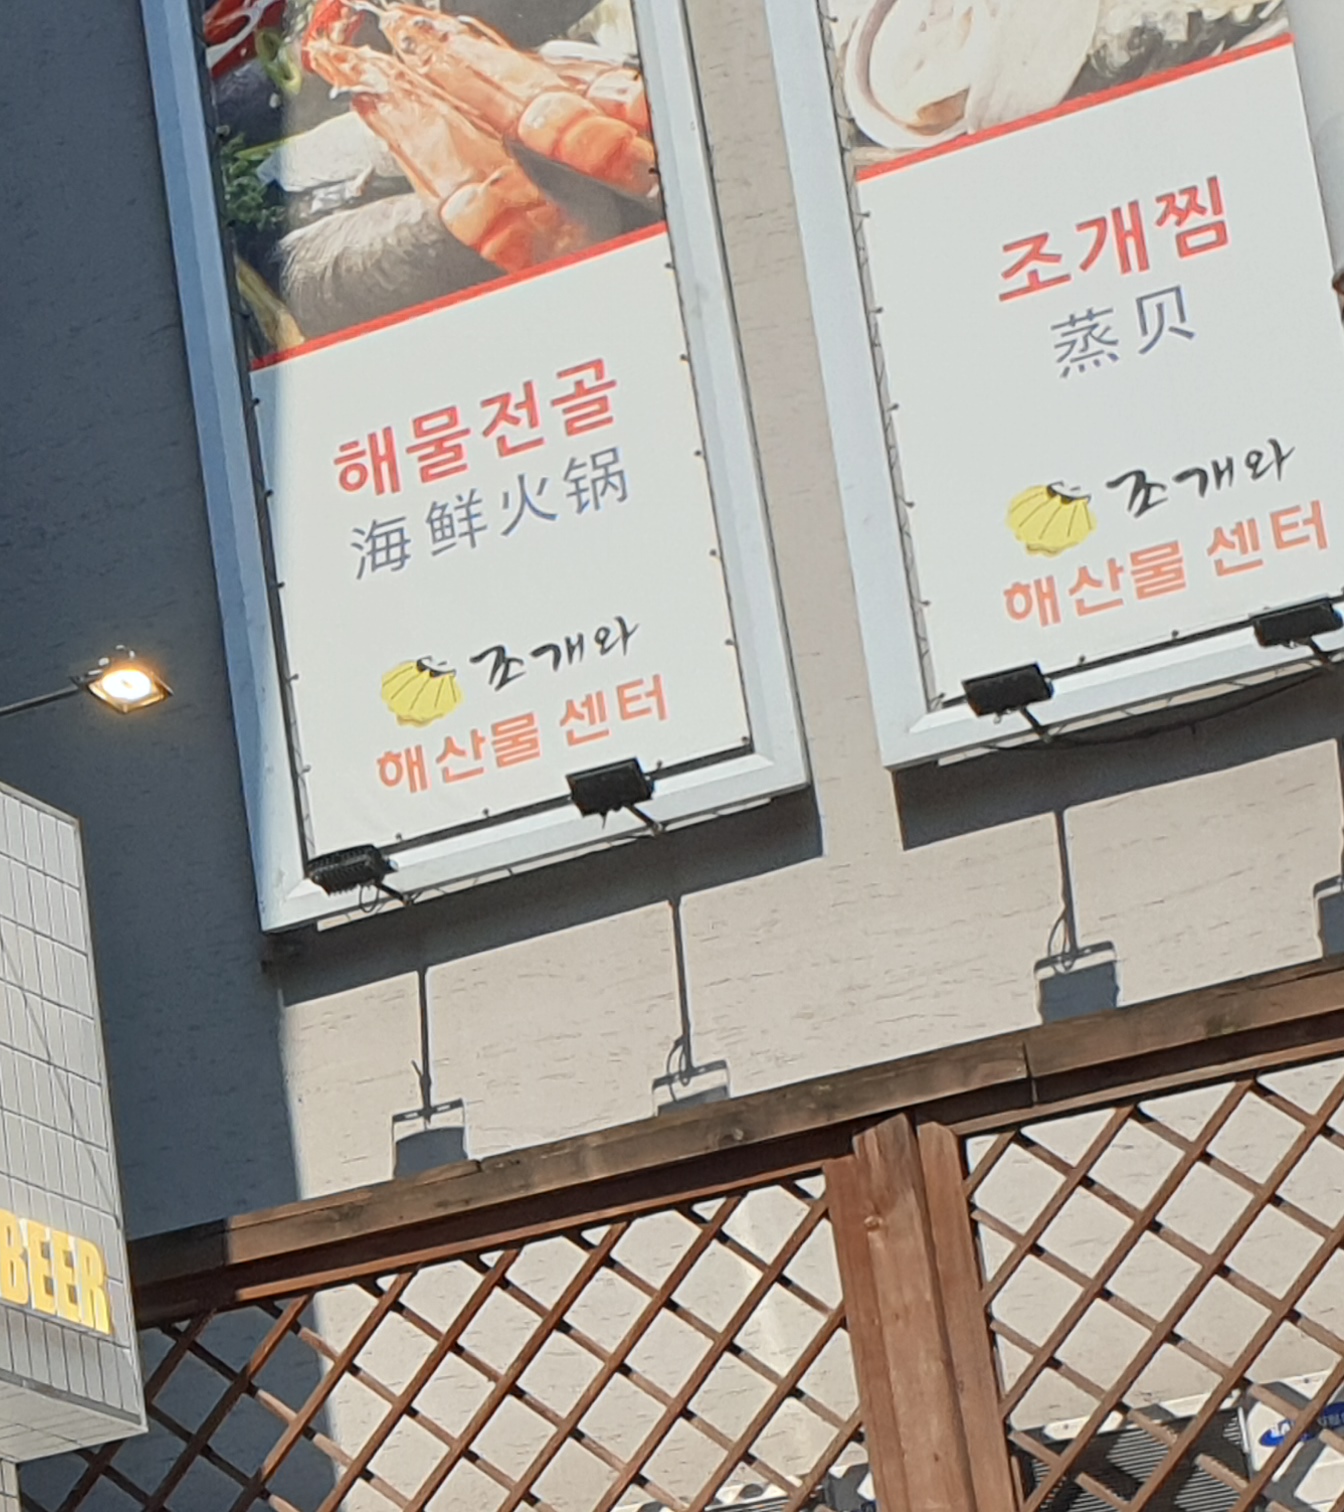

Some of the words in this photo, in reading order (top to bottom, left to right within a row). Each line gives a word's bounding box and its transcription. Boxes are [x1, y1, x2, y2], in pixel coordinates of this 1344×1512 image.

[996, 175, 1233, 303] 조개찜
[1050, 284, 1198, 379] 蒸贝
[332, 357, 619, 498] 해물전골
[1105, 438, 1296, 520] 조개와
[349, 446, 631, 580] 海鲜火锅
[1002, 538, 1186, 629] 해산물
[1204, 497, 1330, 581] 센터
[469, 617, 640, 692] 조개와
[374, 710, 540, 796] 해산물
[555, 673, 670, 750] 센터
